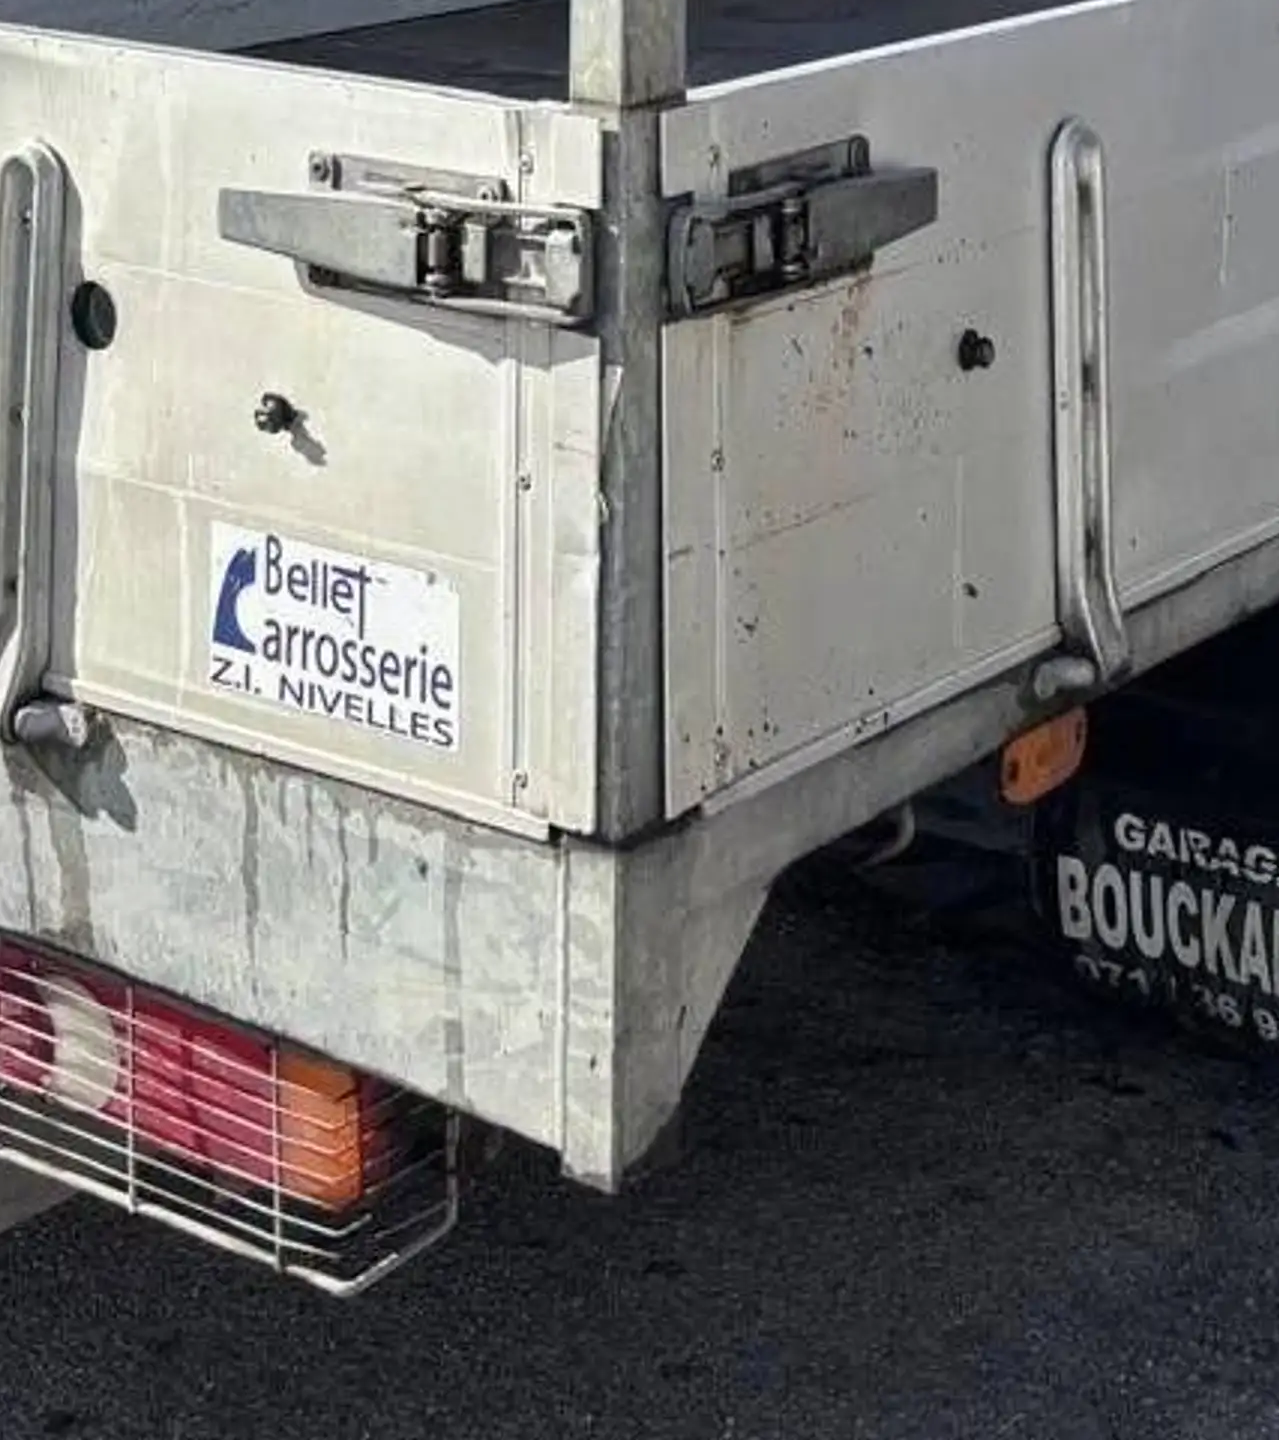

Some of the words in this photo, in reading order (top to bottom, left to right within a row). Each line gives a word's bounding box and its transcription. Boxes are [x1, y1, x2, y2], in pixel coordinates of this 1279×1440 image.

[264, 533, 372, 640] Bellet
[211, 656, 262, 695] Z.I.
[279, 674, 455, 748] NIVELLES
